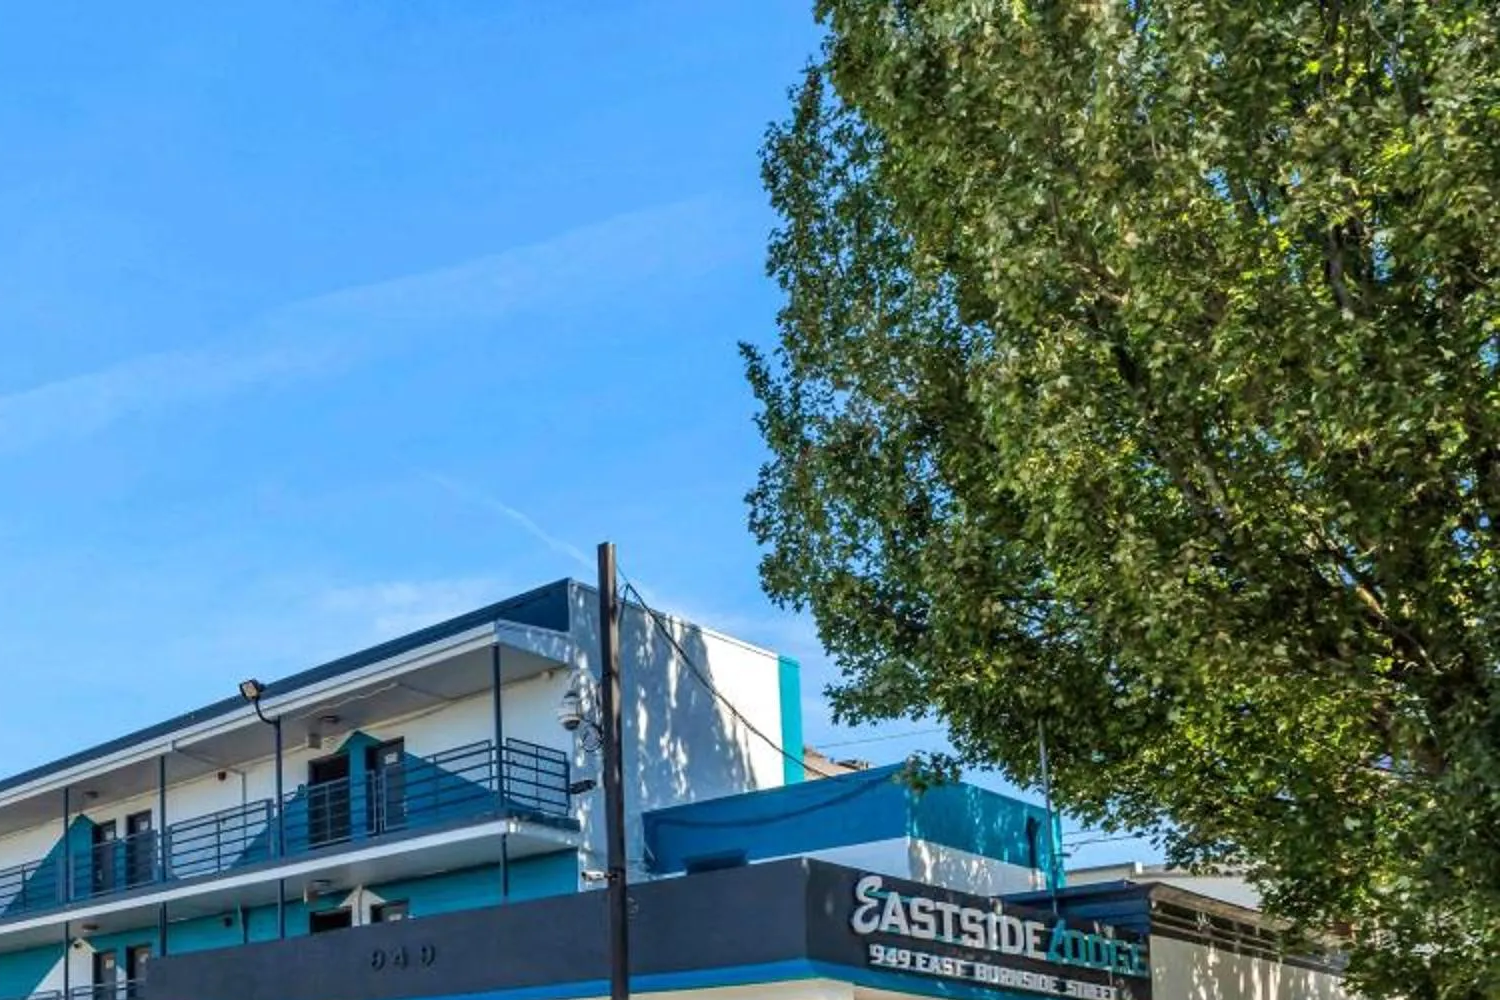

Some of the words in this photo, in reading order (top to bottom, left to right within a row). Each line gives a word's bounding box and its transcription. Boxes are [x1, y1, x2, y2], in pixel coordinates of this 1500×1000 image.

[853, 876, 1047, 960] EASTSIDE
[371, 945, 436, 972] 949
[869, 943, 911, 970] 949
[913, 951, 965, 977] EAST
[975, 962, 1061, 994] BURNSIDE
